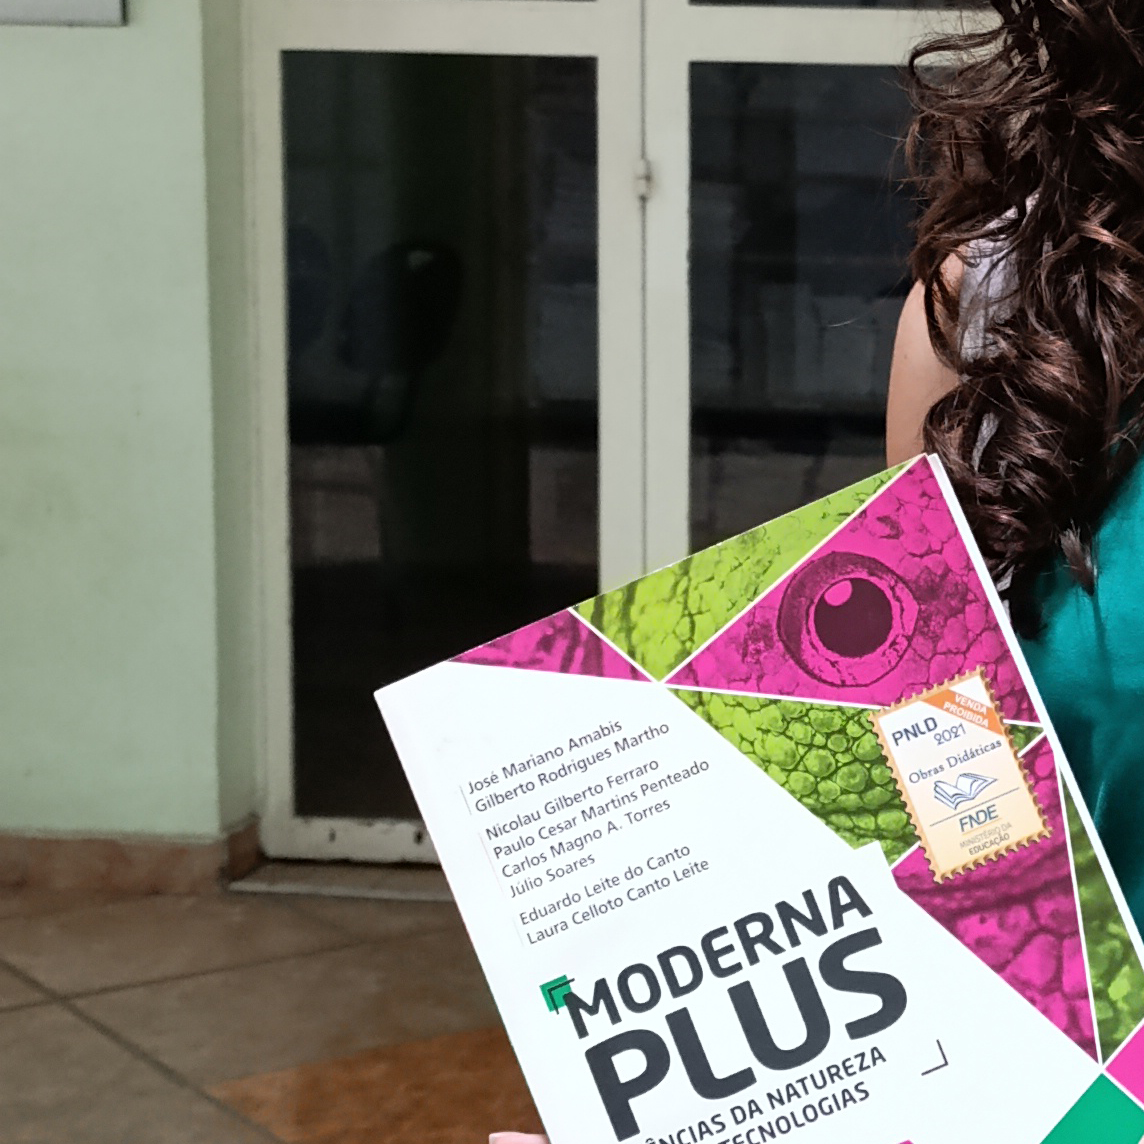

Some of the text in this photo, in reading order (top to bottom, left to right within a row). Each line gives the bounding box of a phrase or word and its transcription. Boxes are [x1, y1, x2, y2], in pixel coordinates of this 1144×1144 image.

[891, 716, 938, 747] PNLD
[933, 723, 967, 746] 2021
[943, 701, 989, 729] PROIBIDA
[955, 693, 987, 715] VENDA
[468, 720, 623, 795] José Mariano Amabis
[475, 723, 670, 813] Gilberto Rodrigues Martho
[908, 740, 1002, 784] Obras Didáticas
[485, 759, 660, 841] Nicolau Gilberto Ferraro
[493, 758, 710, 860] Paulo Cesar Martins Penteado
[959, 804, 999, 832] FNDE
[960, 822, 1012, 847] MINISTÉRIO DA
[501, 798, 671, 879] Carlos Magno A. Torres
[509, 853, 596, 898] Júlio Soares
[968, 832, 1010, 855] EDUCAÇÃO
[519, 845, 691, 926] Eduardo Leite do Canto
[526, 858, 710, 945] Laura Celloto Canto Leite
[563, 875, 873, 1039] MODERNA
[585, 926, 908, 1142] PLUS
[729, 1099, 764, 1126] DA
[766, 1046, 887, 1111] NATUREZA
